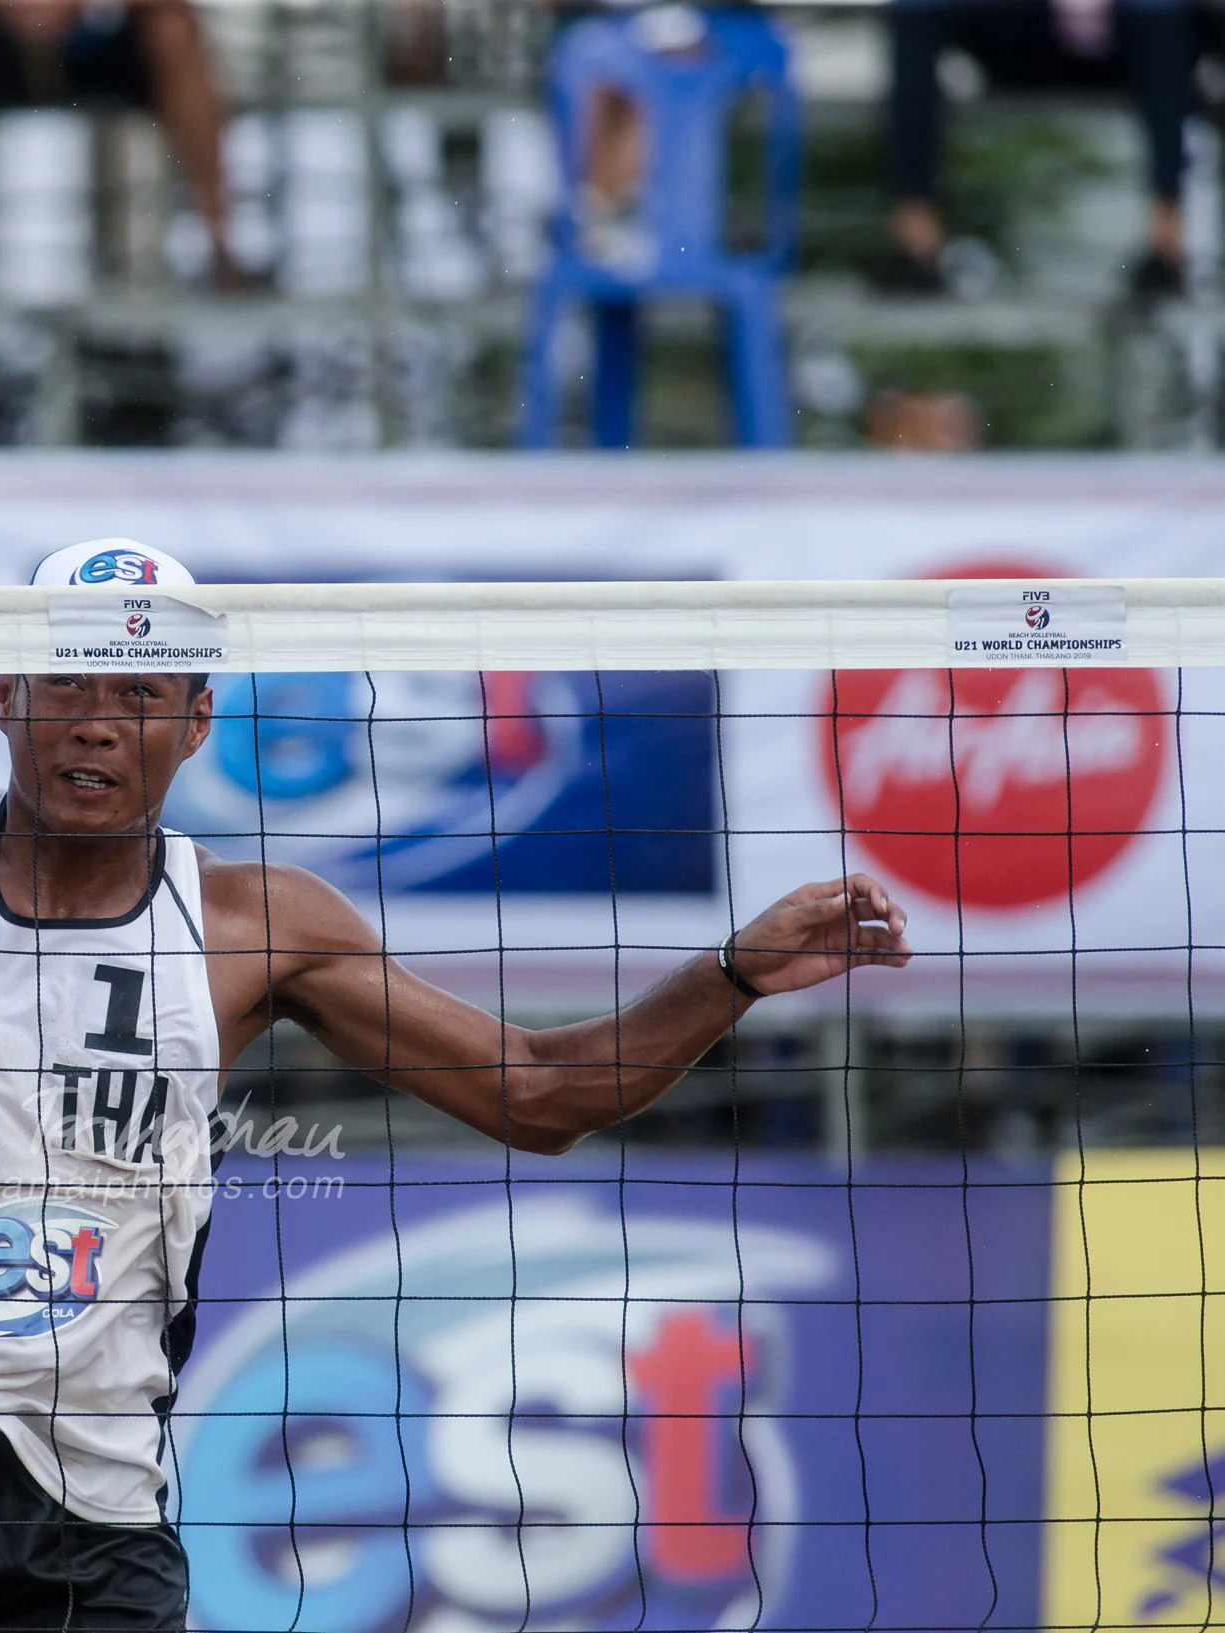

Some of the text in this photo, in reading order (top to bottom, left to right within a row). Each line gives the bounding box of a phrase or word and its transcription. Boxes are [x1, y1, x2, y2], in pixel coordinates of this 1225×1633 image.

[79, 554, 159, 585] est
[1022, 591, 1050, 600] FIVB
[123, 600, 151, 609] FIVB
[954, 639, 1122, 651] U21 WORLD CHAMPIONSHIPS
[55, 647, 223, 658] U21 WORLD CHAMPIONSHIPS
[1073, 652, 1092, 660] 2019
[86, 660, 109, 668] UDON
[136, 660, 173, 668] THAILAND
[173, 660, 192, 668] 2019
[84, 963, 153, 1056] 1
[52, 1062, 169, 1165] THA
[180, 1308, 759, 1633] est
